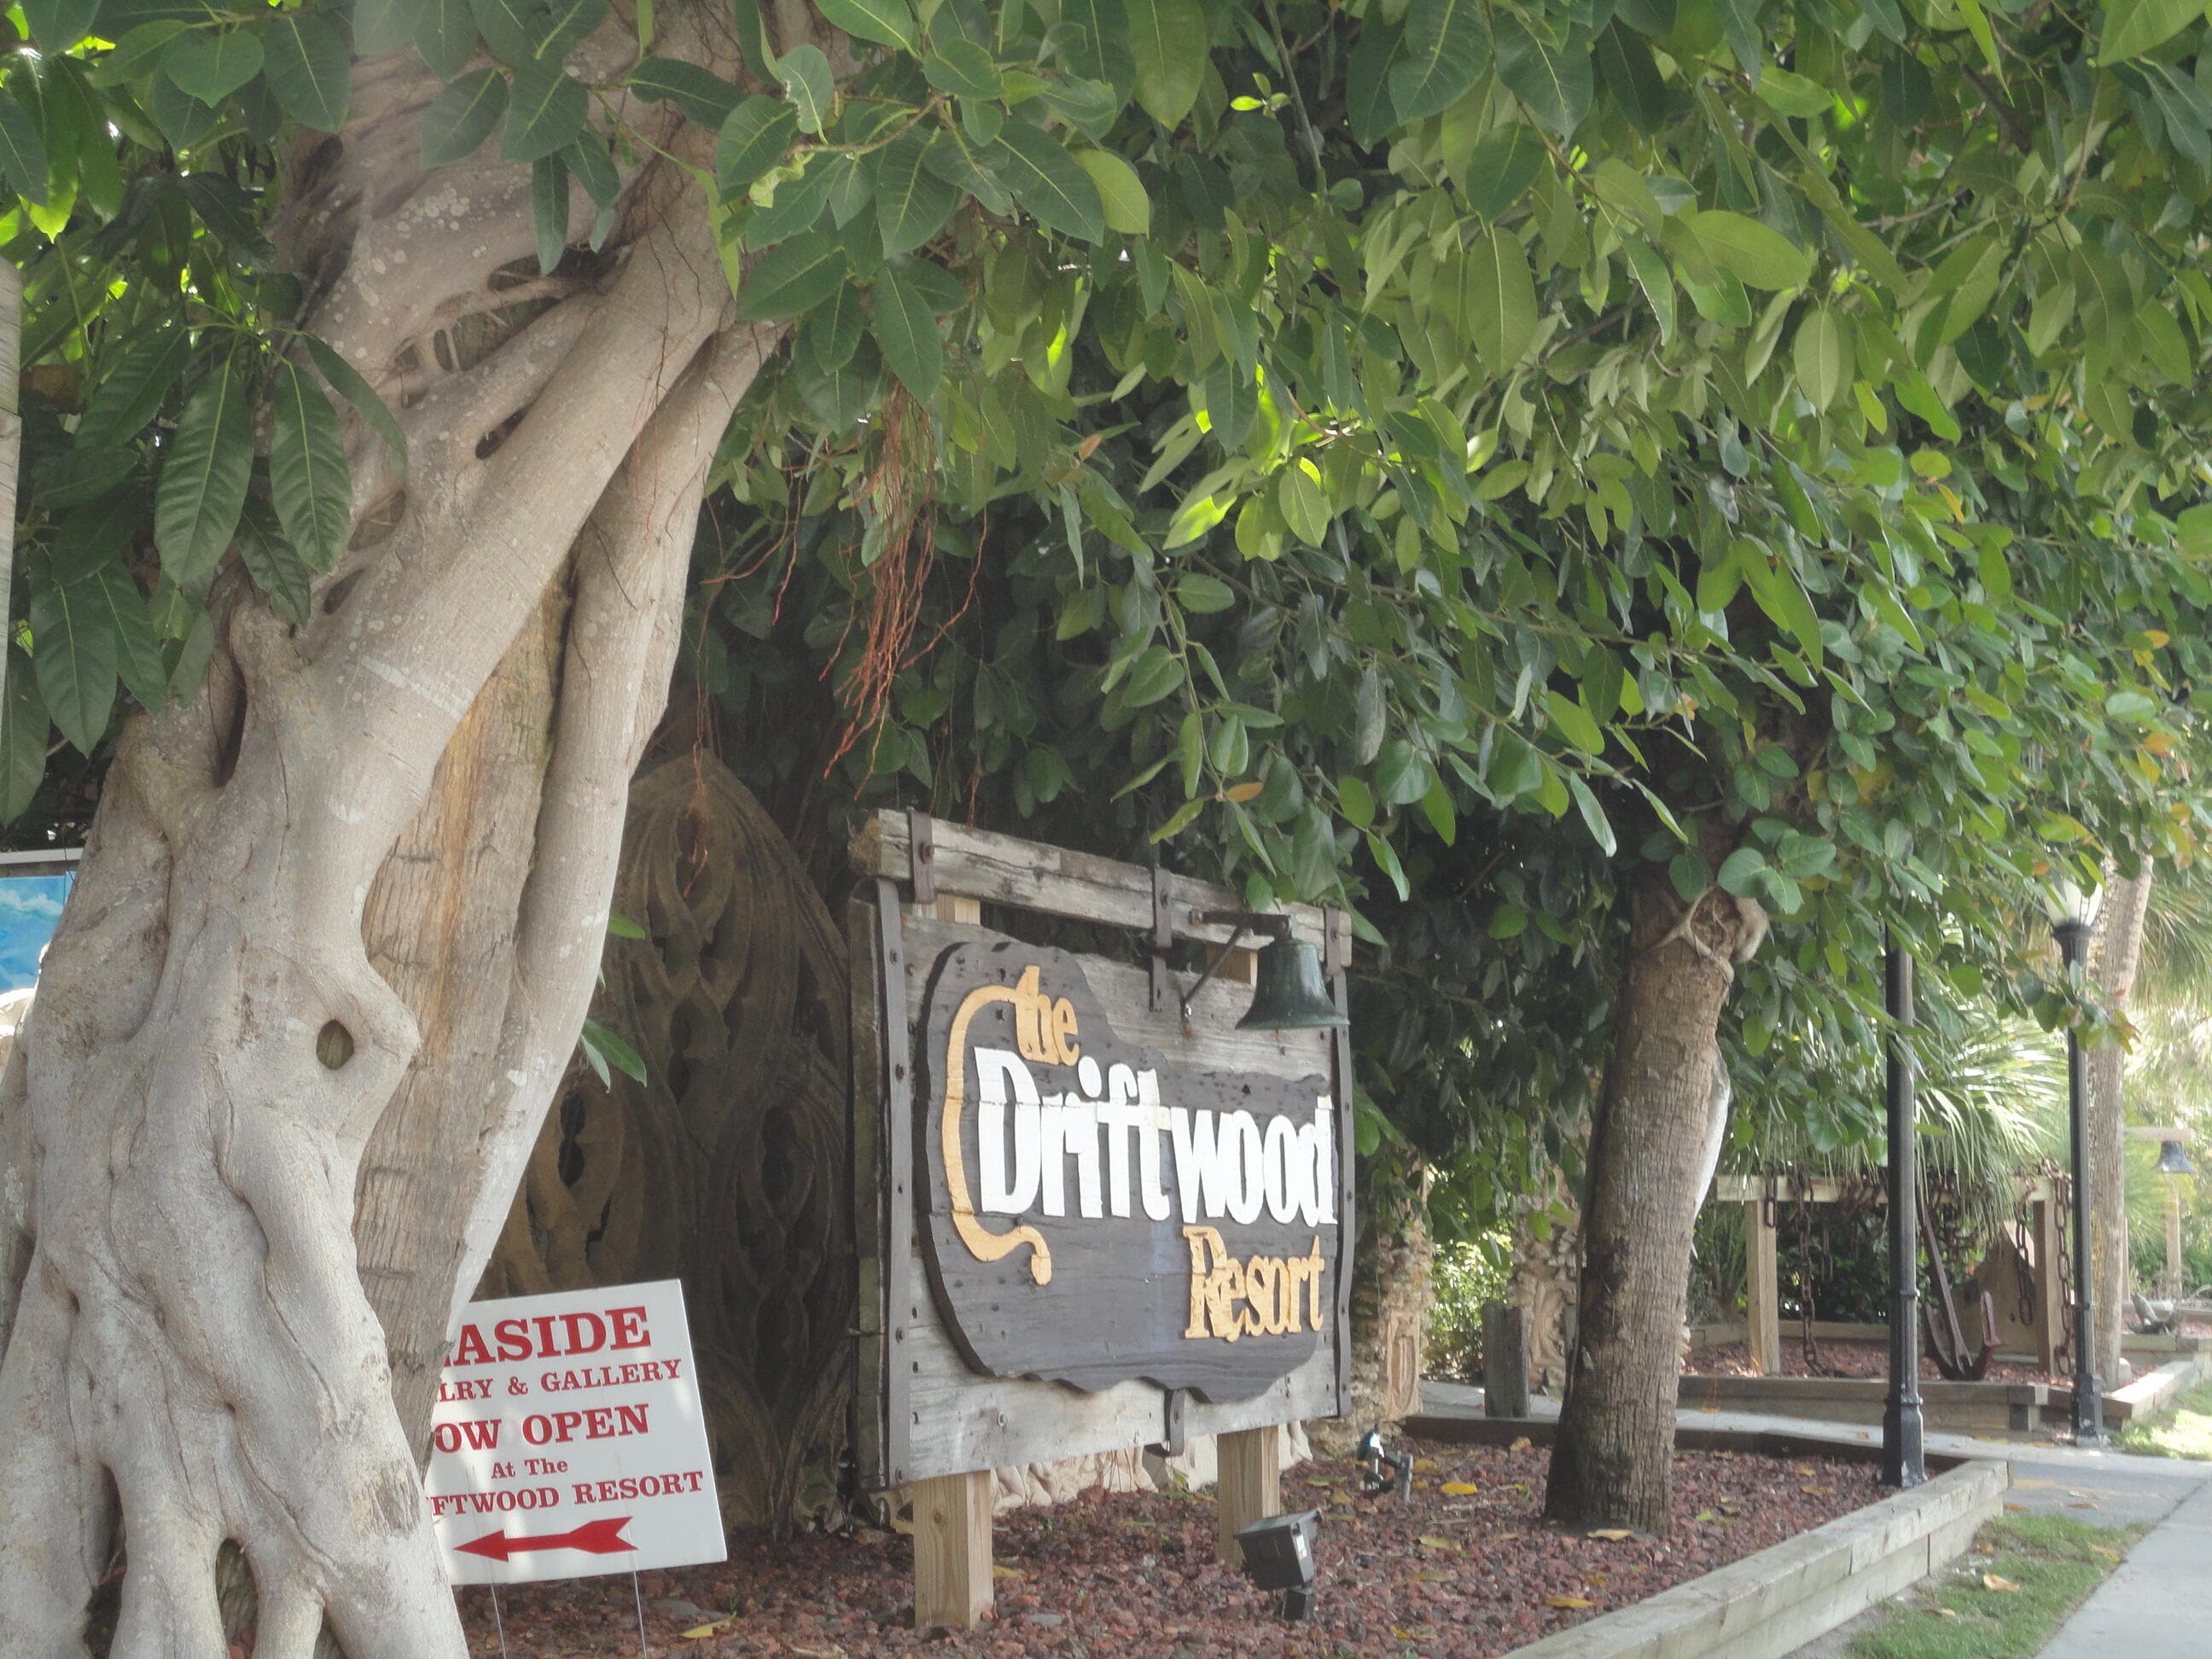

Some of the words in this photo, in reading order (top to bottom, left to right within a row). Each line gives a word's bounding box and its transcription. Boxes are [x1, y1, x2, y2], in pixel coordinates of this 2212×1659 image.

[1015, 965, 1080, 1066] the
[974, 1046, 1338, 1227] Driftwood
[1183, 1225, 1325, 1342] Resort
[444, 1306, 652, 1367] ASIDE
[436, 1378, 493, 1402] LRY
[508, 1376, 528, 1396] &
[540, 1359, 682, 1392] GALLERY
[434, 1418, 502, 1453] OW
[522, 1404, 649, 1446] OPEN
[426, 1487, 560, 1516] FTWOOD
[572, 1470, 703, 1505] RESORT
[491, 1461, 515, 1479] At
[524, 1458, 568, 1476] The
